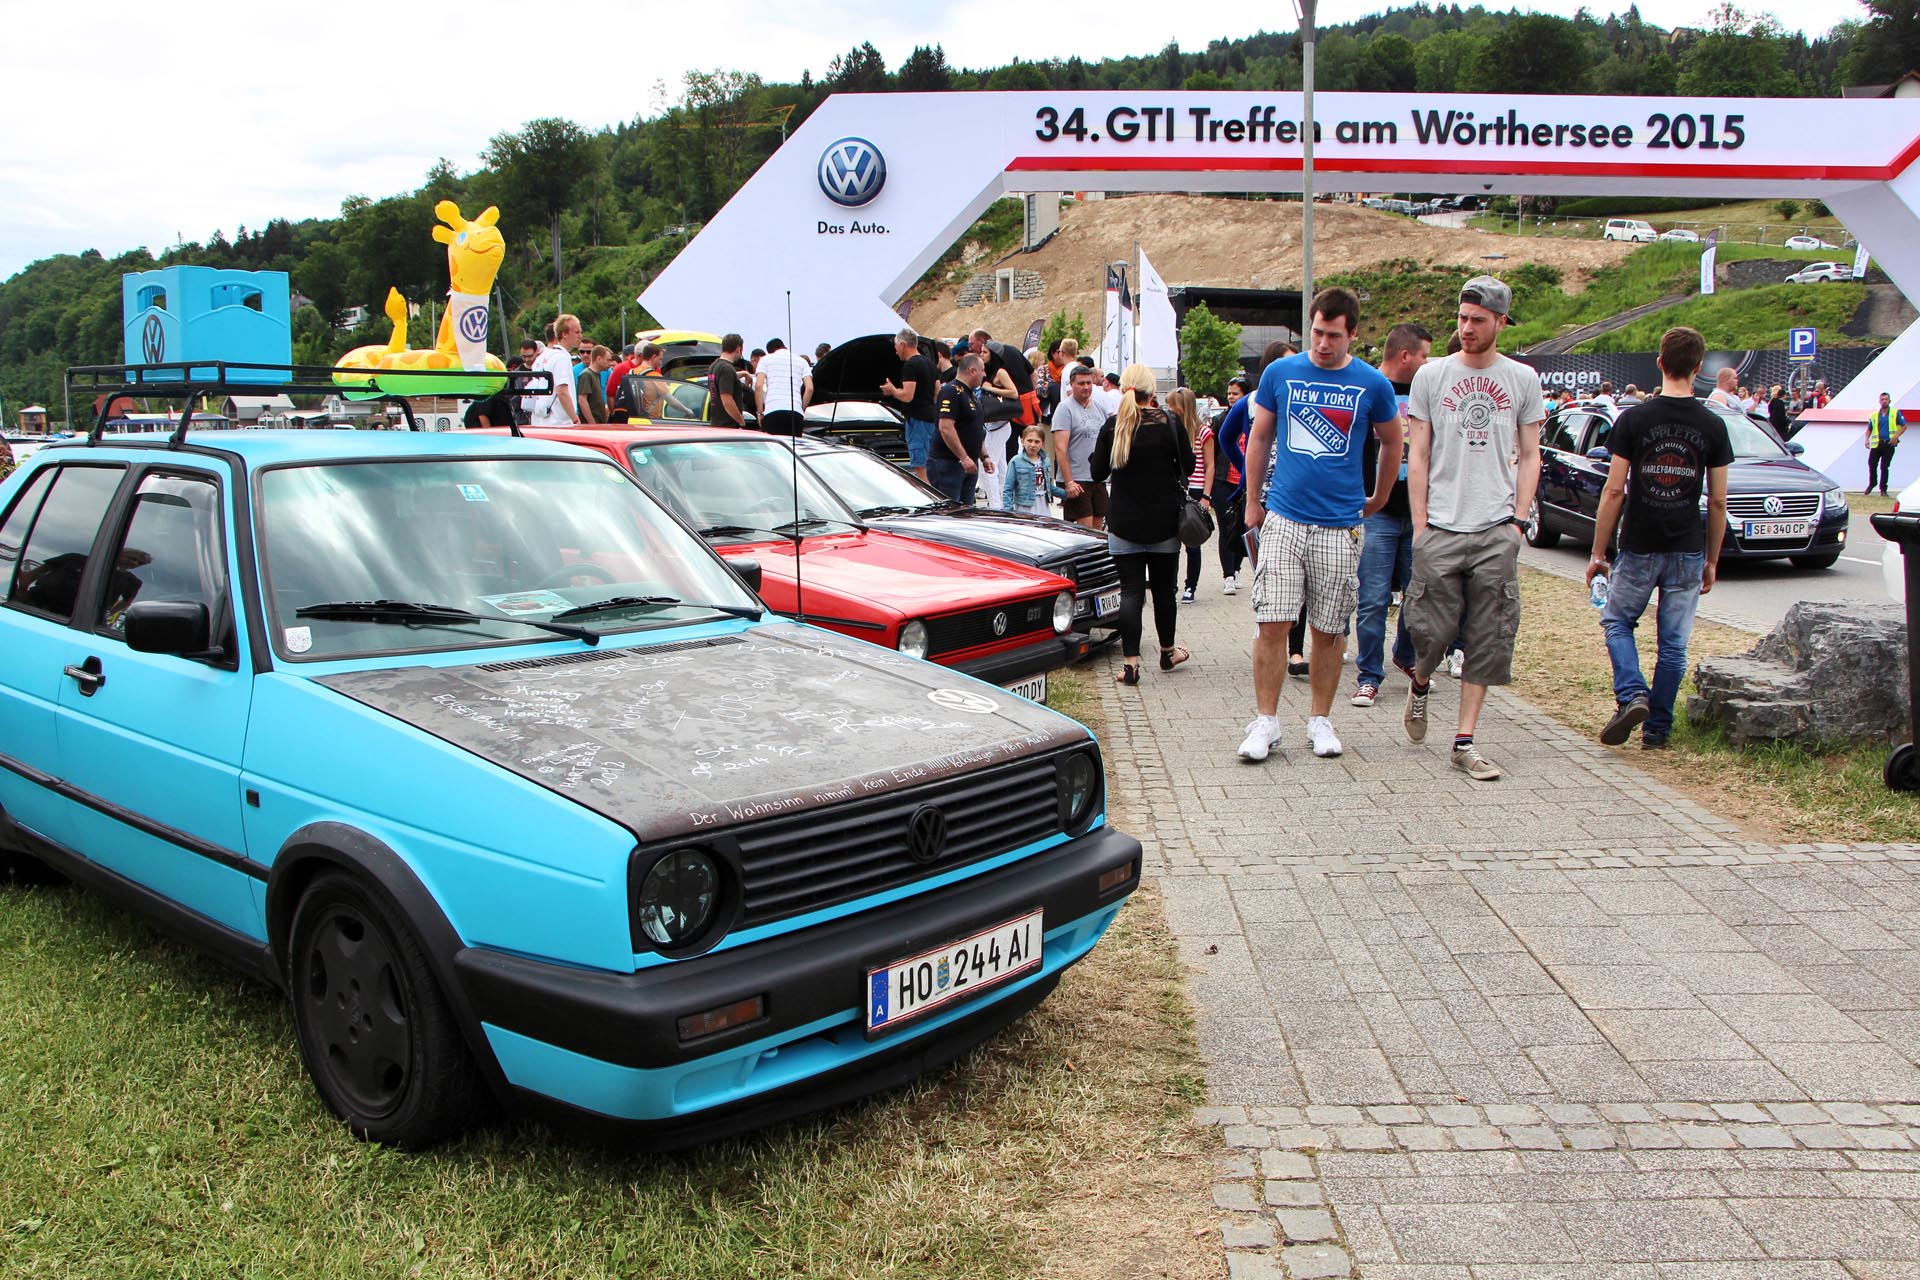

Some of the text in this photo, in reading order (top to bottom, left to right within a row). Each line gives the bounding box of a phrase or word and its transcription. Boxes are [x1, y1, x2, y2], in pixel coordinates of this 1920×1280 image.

[1035, 106, 1745, 149] 34. GTI Treffen am Wörthersee 2015
[818, 221, 891, 234] Das Auto.
[1794, 331, 1813, 353] P
[1292, 389, 1354, 407] NEW YORK
[1442, 397, 1458, 412] JP
[1451, 376, 1512, 412] PERFORMANCE
[1299, 406, 1345, 450] RANGERS
[1642, 427, 1706, 450] APPLETON
[1655, 442, 1688, 454] GENUINE
[1641, 464, 1696, 477] HARLEY-DAVIDSON
[1650, 486, 1681, 497] DEALER
[1754, 524, 1805, 534] SE 340 CP
[1027, 607, 1042, 621] GTI
[1031, 679, 1043, 700] DY
[689, 812, 719, 826] Der
[725, 797, 804, 820] Wahnsinn
[814, 783, 855, 803] nimmt
[860, 776, 889, 791] kein
[949, 751, 993, 769] Volkswagen
[1001, 741, 1025, 754] Mein
[1026, 729, 1055, 748] Auto!
[899, 924, 1030, 1010] HO 244 AI
[875, 1005, 884, 1018] A
